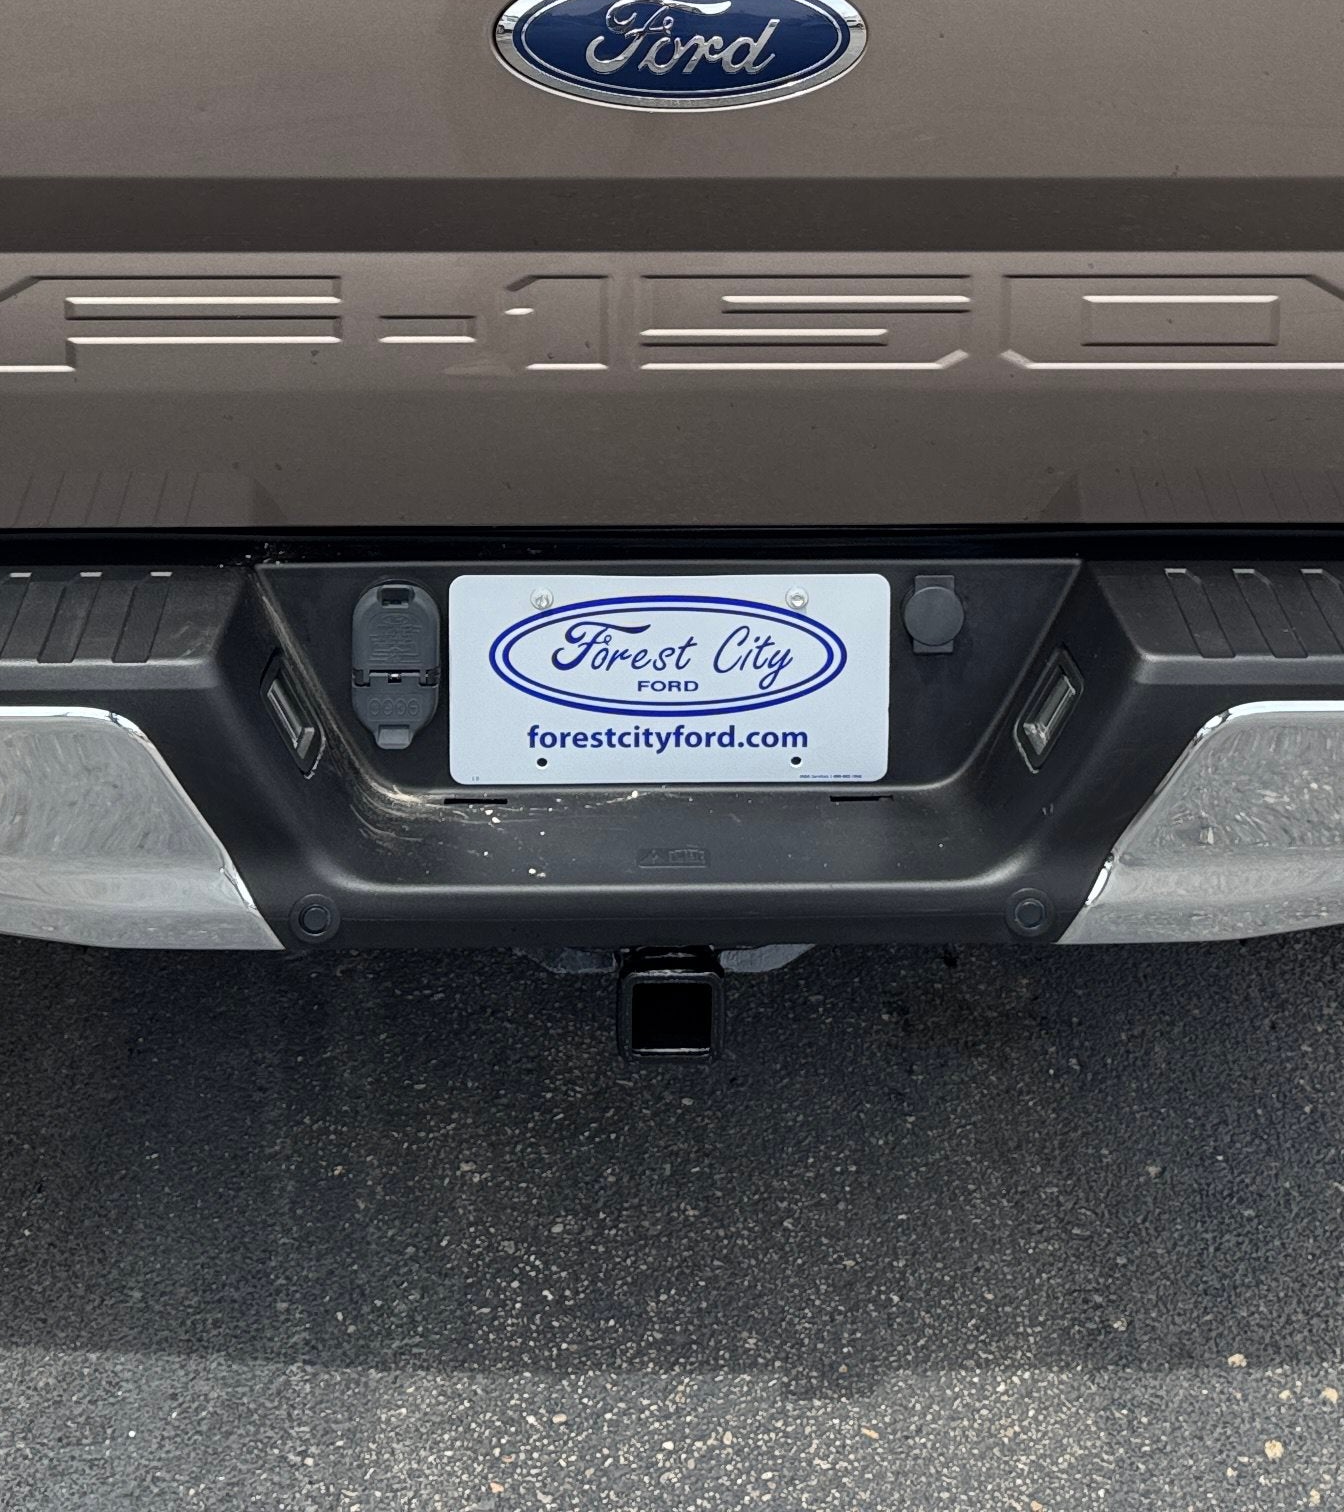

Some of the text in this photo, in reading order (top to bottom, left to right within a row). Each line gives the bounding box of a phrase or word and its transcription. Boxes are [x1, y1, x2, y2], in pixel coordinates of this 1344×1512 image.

[551, 621, 794, 690] Forest City
[637, 680, 699, 693] FORD
[527, 724, 809, 754] forestcityford.com
